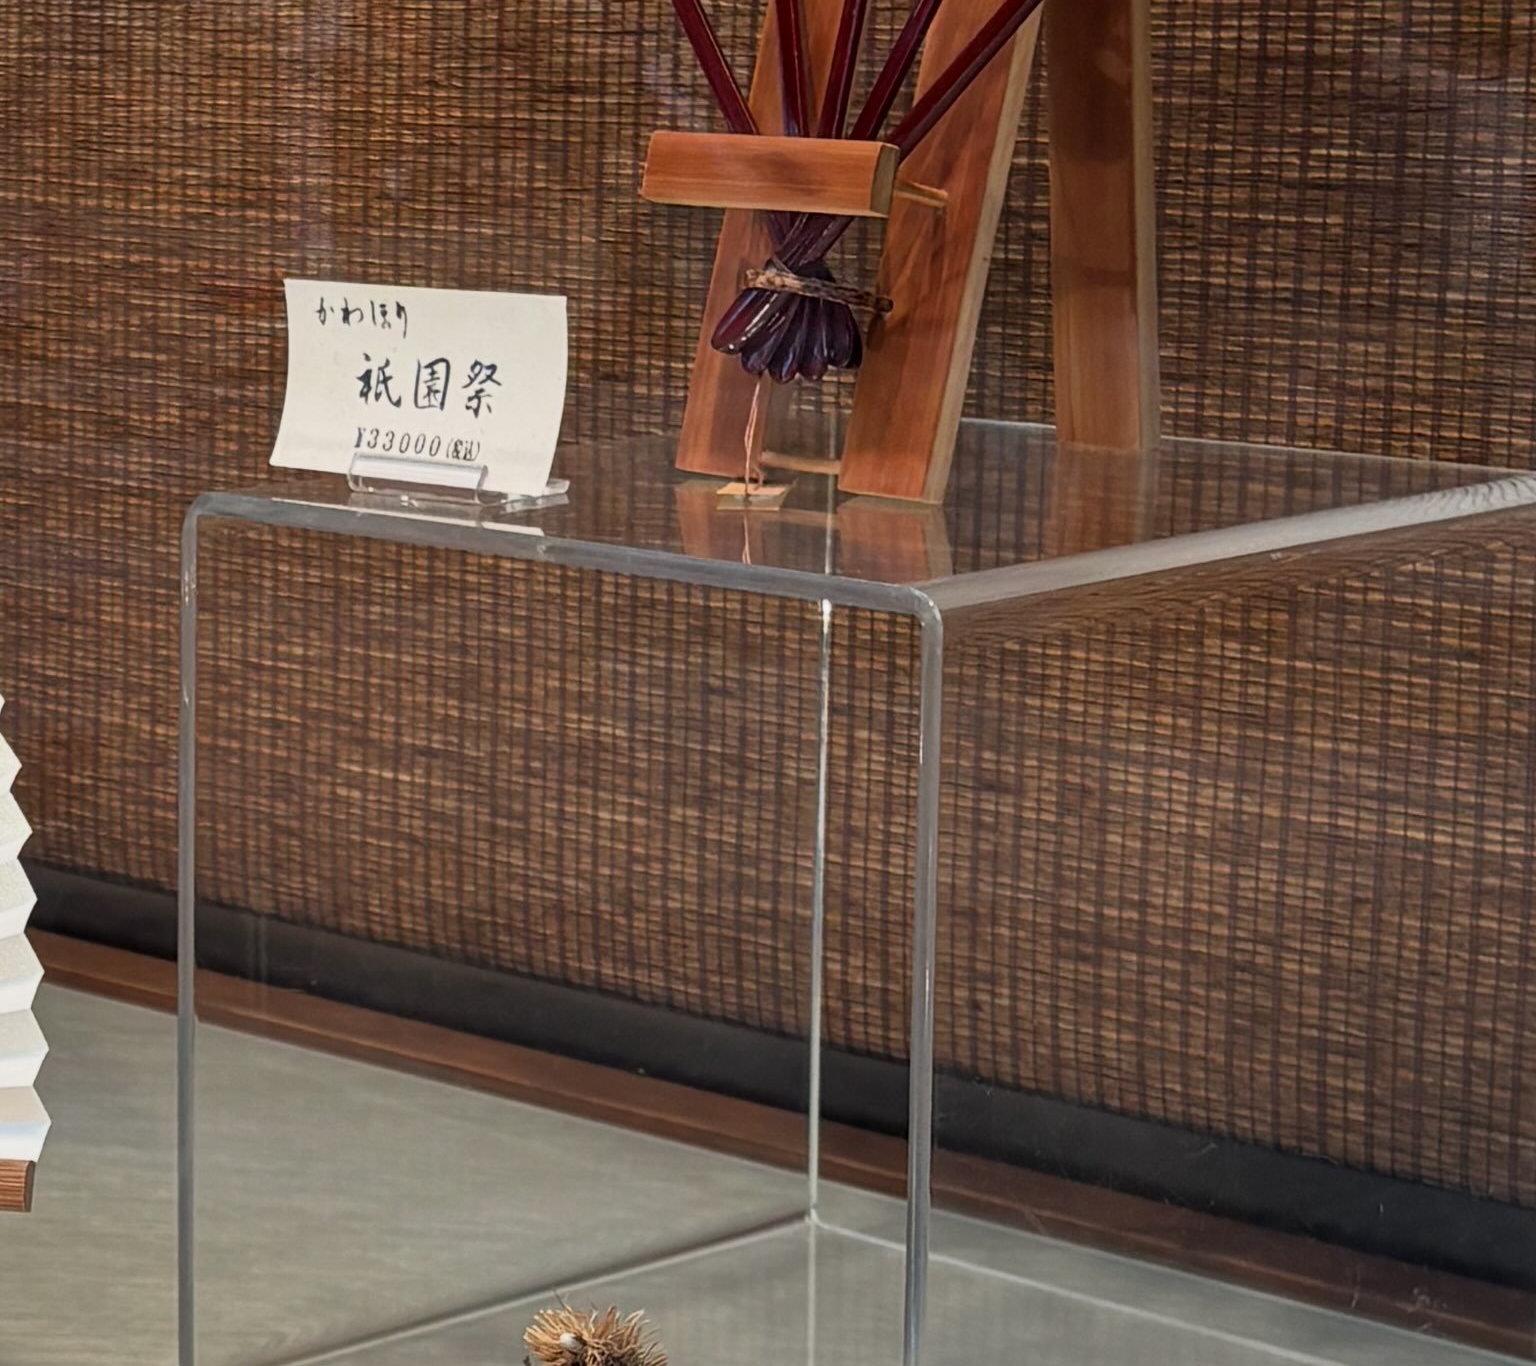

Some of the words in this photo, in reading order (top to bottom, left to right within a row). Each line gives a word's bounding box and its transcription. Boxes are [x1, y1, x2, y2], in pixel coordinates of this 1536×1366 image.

[314, 296, 409, 339] かわほり
[355, 352, 503, 420] 祇園祭
